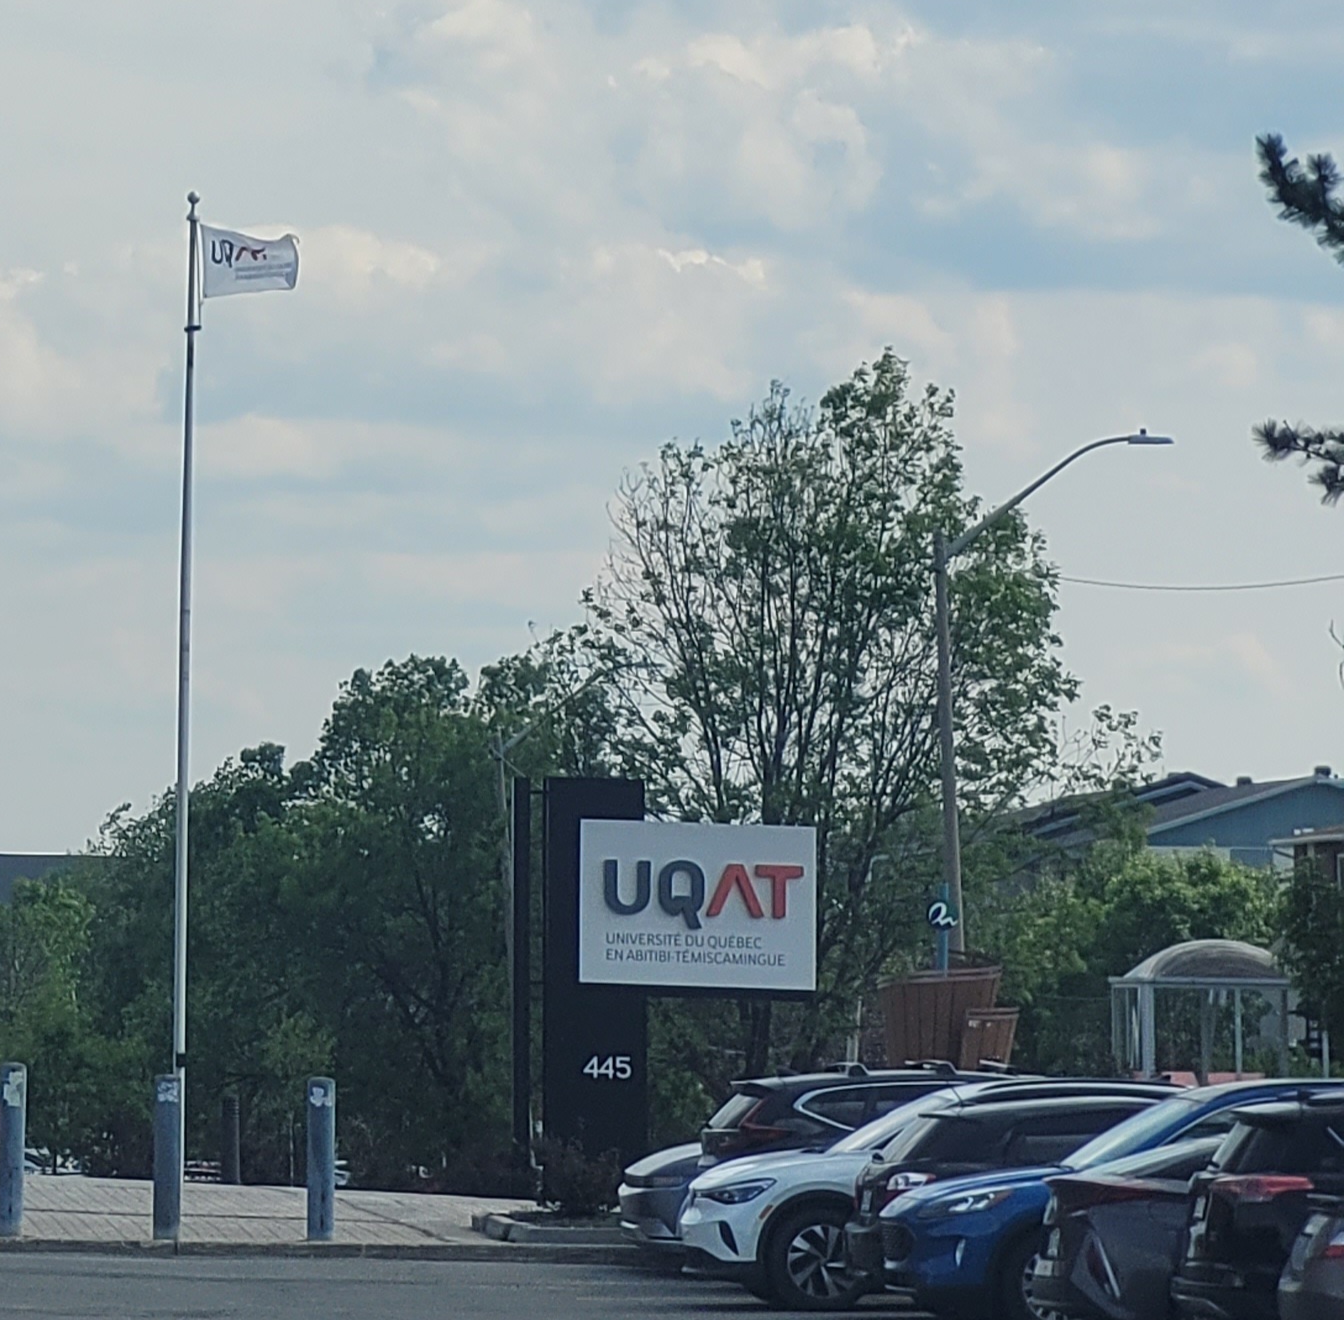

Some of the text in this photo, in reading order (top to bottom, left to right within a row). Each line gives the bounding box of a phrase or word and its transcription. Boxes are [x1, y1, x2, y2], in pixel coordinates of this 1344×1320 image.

[602, 858, 805, 930] UQAT
[605, 932, 762, 950] UNIVERSITÉ DU QUÉBEC
[605, 948, 787, 967] EN ABITIBI-TÉMISCAMINGUE
[582, 1055, 632, 1079] 445
